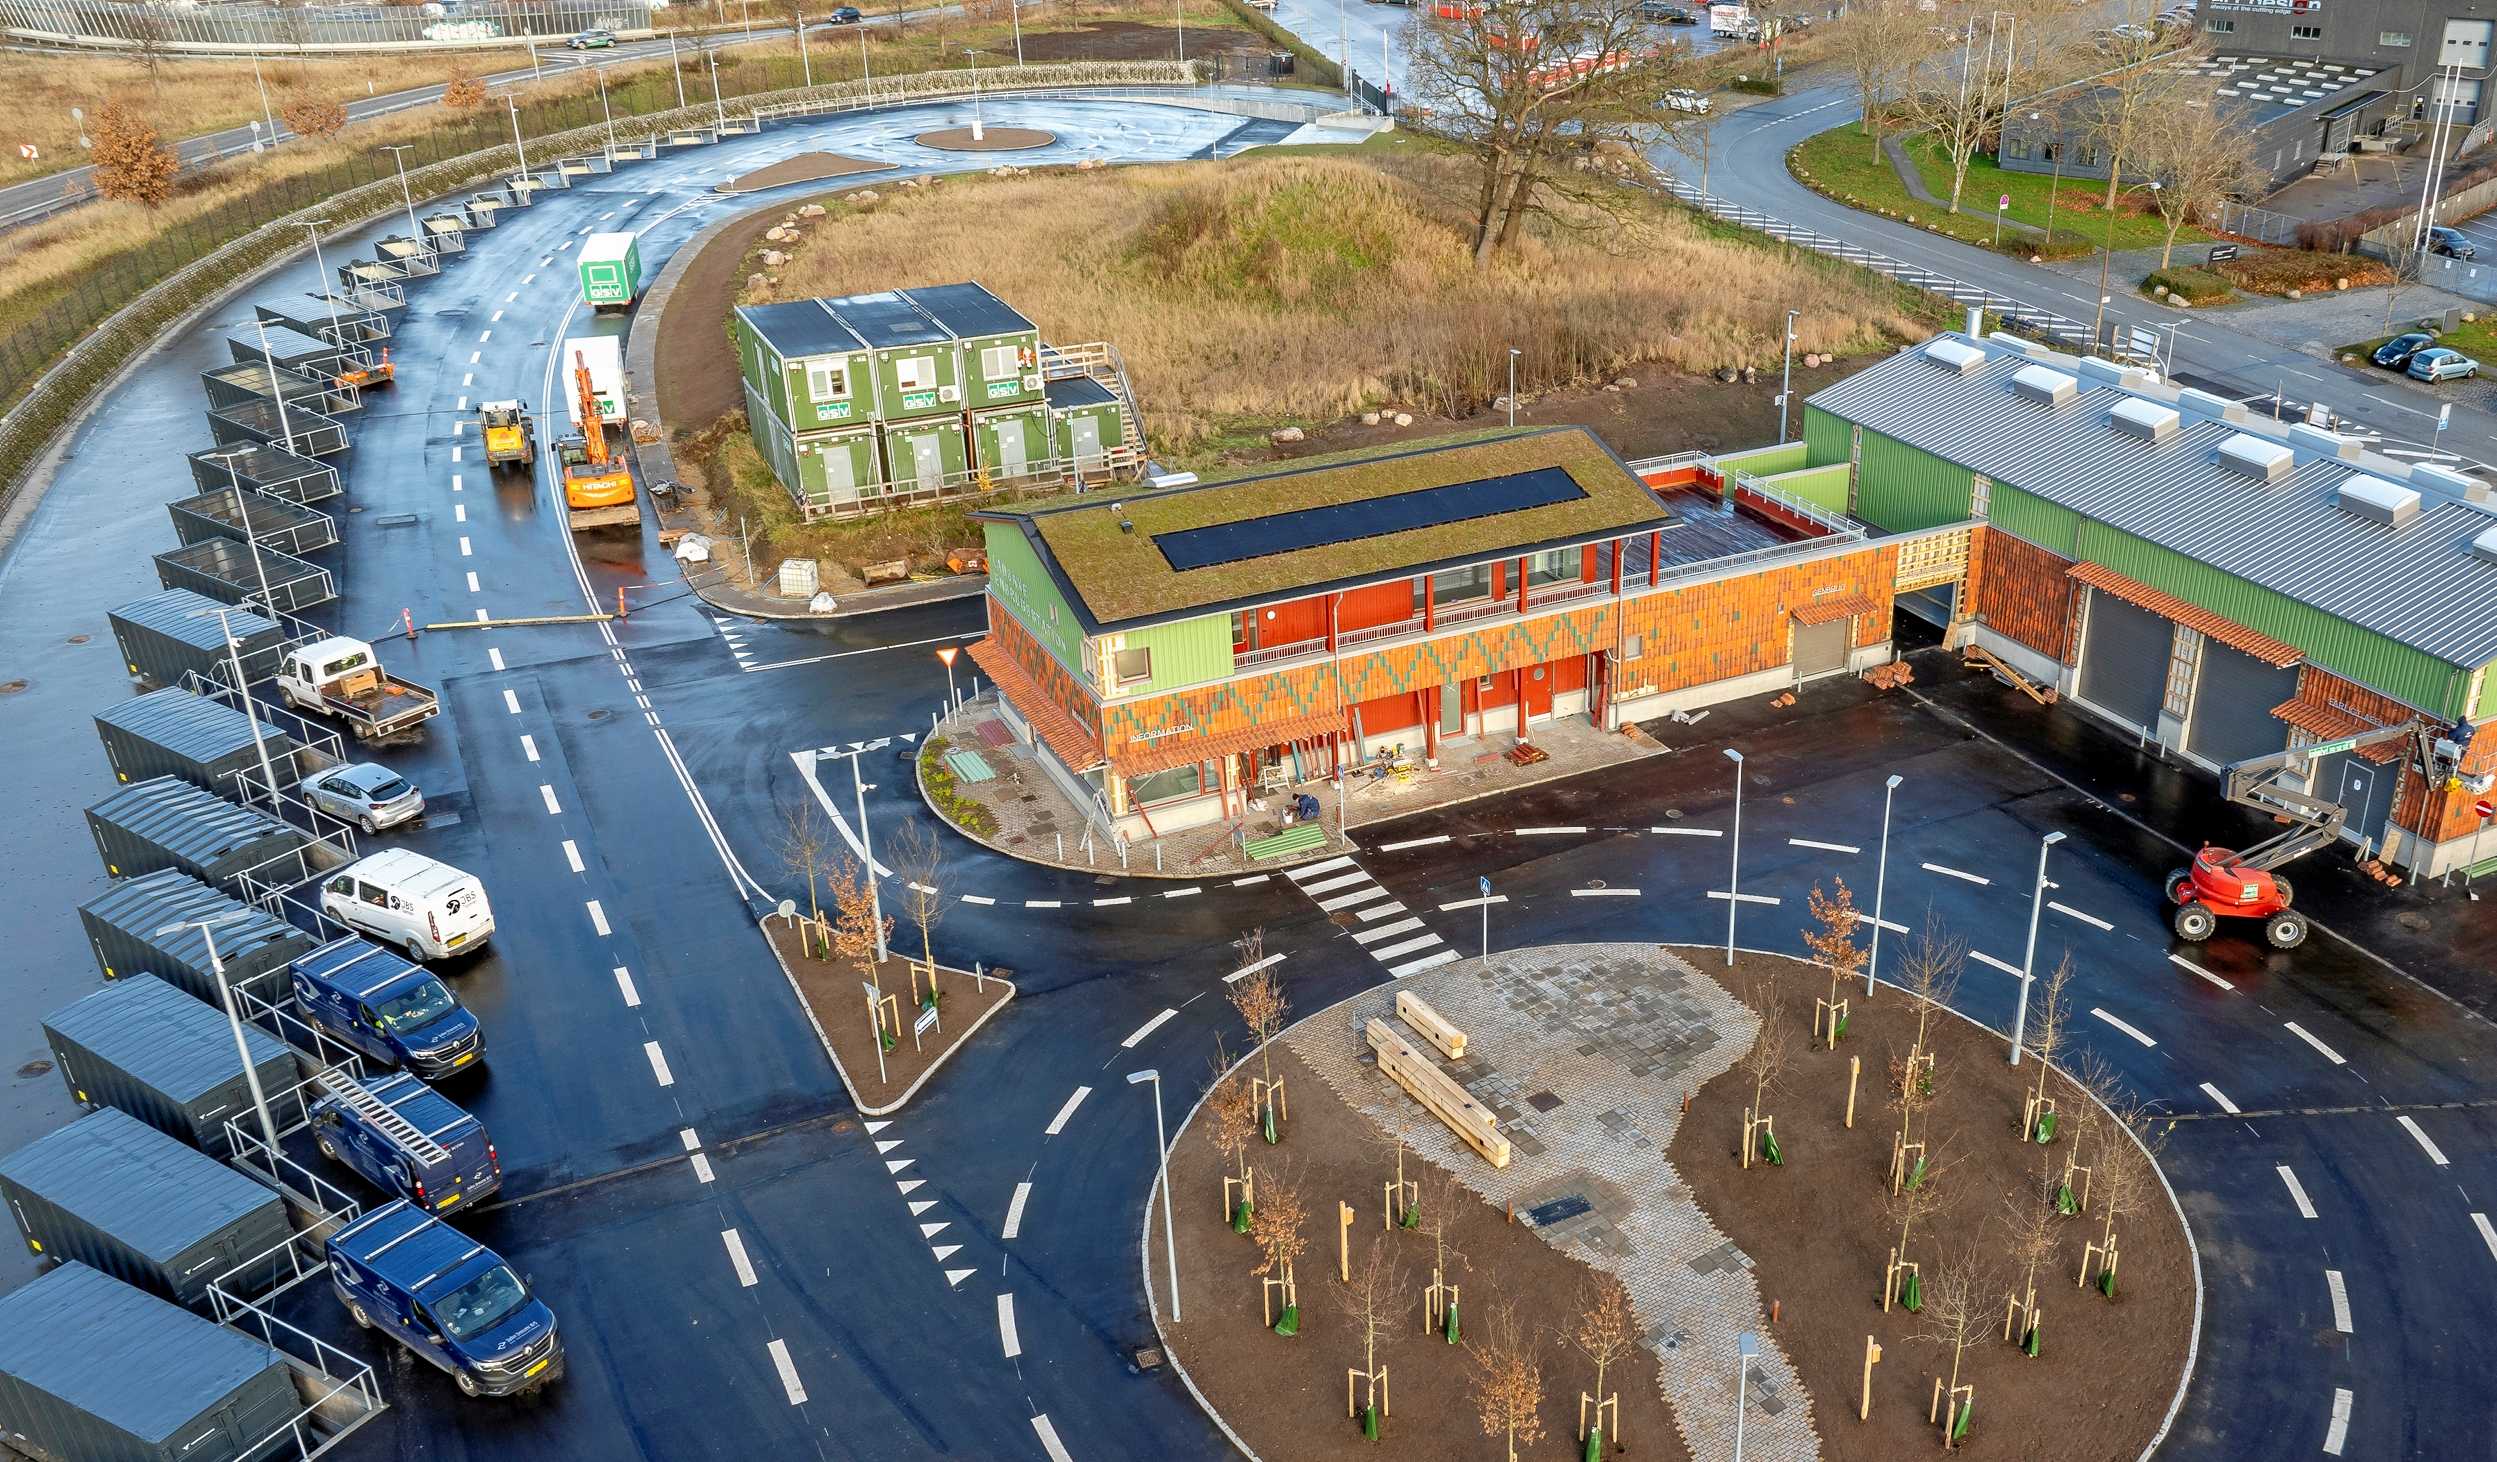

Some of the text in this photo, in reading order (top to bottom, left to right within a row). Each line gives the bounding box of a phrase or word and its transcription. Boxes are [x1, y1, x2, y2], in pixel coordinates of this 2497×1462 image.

[592, 287, 621, 297] GSV
[989, 386, 1018, 397] GSV
[905, 397, 935, 408] GSV
[819, 407, 850, 419] GSV
[582, 481, 617, 490] HITACHI
[1812, 583, 1846, 596] GENBRUG
[2329, 697, 2394, 728] FARLIGT AFFAL
[1130, 723, 1193, 742] INFORMATION
[460, 890, 477, 905] JBS
[401, 899, 414, 912] JBS
